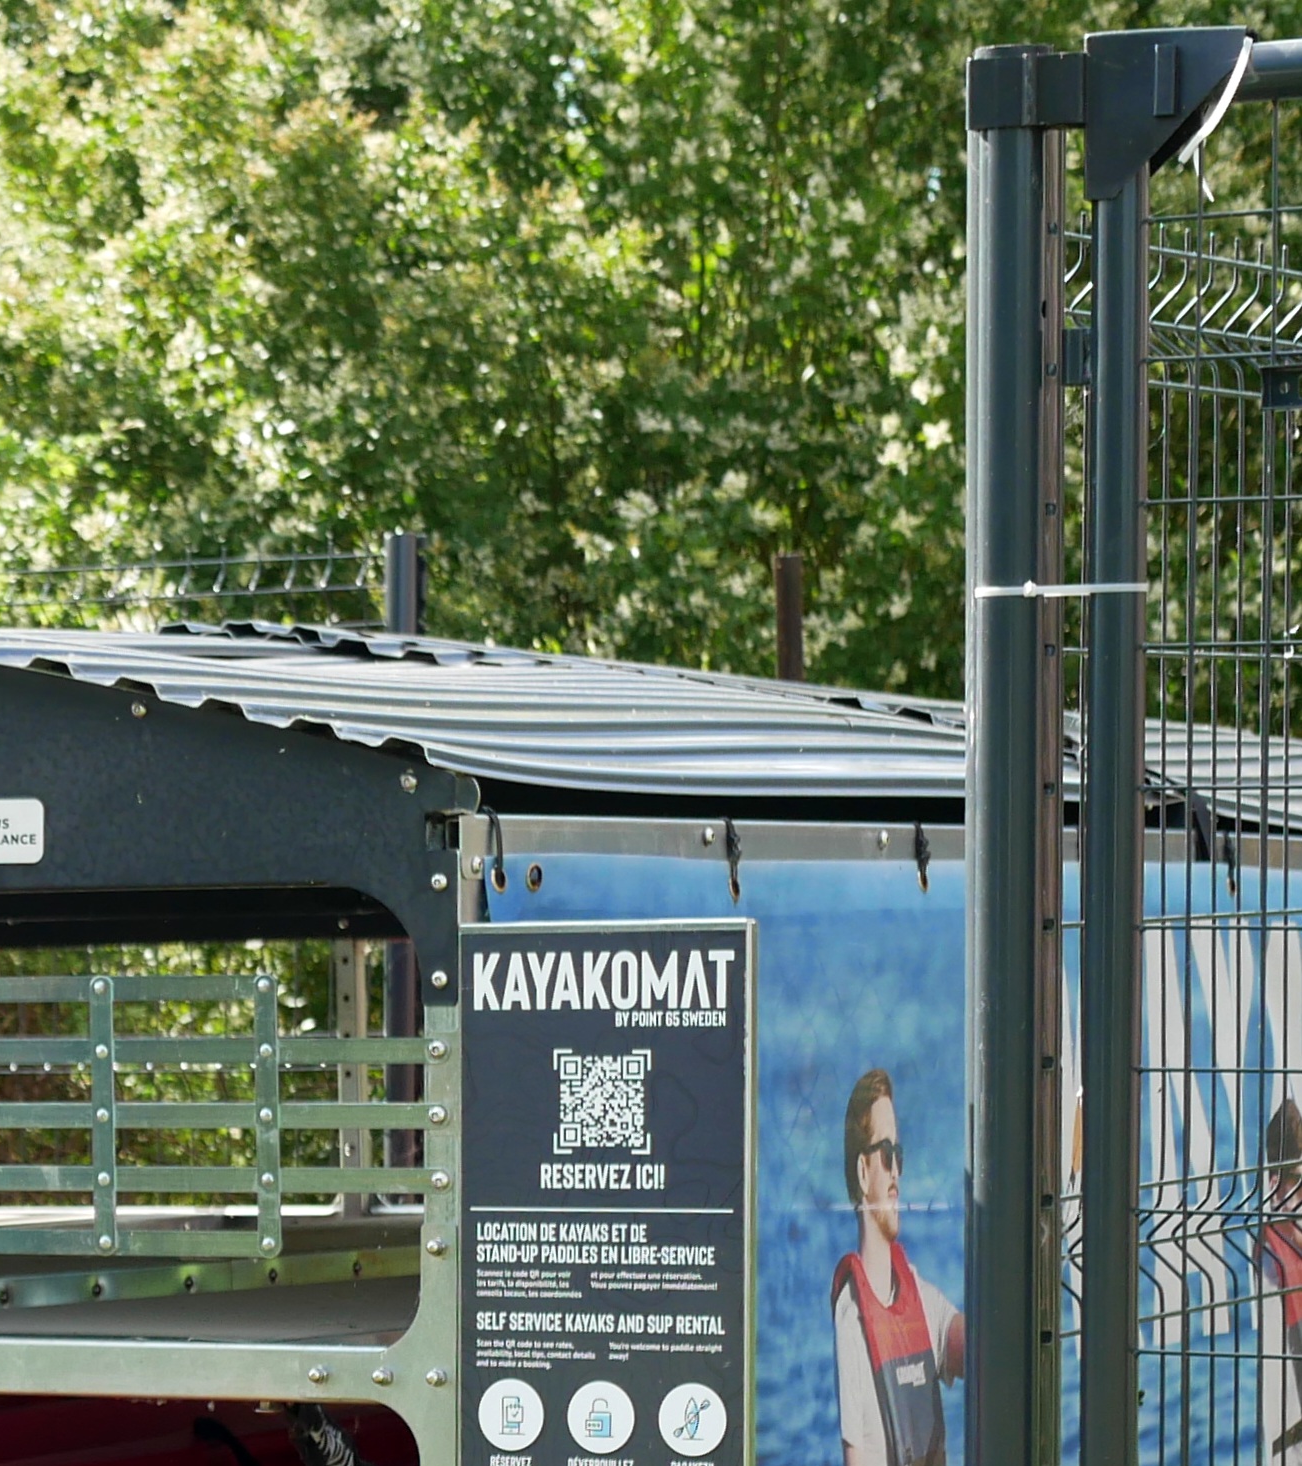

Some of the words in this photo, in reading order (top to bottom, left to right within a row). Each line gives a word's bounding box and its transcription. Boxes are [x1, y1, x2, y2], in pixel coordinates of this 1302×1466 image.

[473, 950, 735, 1011] KAYAKOMAT
[615, 1012, 629, 1027] BY
[632, 1012, 663, 1027] POINT
[665, 1011, 680, 1027] 65
[682, 1011, 726, 1027] SWEDEN
[540, 1164, 632, 1190] RESERVEZ
[635, 1164, 665, 1190] ICI!
[476, 1222, 537, 1242] LOCATION
[540, 1223, 556, 1242] DE
[559, 1223, 609, 1243] KAYAKS
[611, 1224, 627, 1243] ET
[630, 1224, 647, 1243] DE
[476, 1244, 539, 1264] STAND-UP
[541, 1245, 598, 1264] PADDLES
[601, 1246, 618, 1265] EN
[620, 1246, 715, 1266] LIBRE-SERVICE
[476, 1312, 507, 1332] SELF
[509, 1312, 562, 1332] SERVICE
[565, 1313, 614, 1333] KAYAKS
[617, 1314, 645, 1333] AND
[647, 1315, 673, 1334] SUP
[676, 1315, 726, 1335] RENTAL
